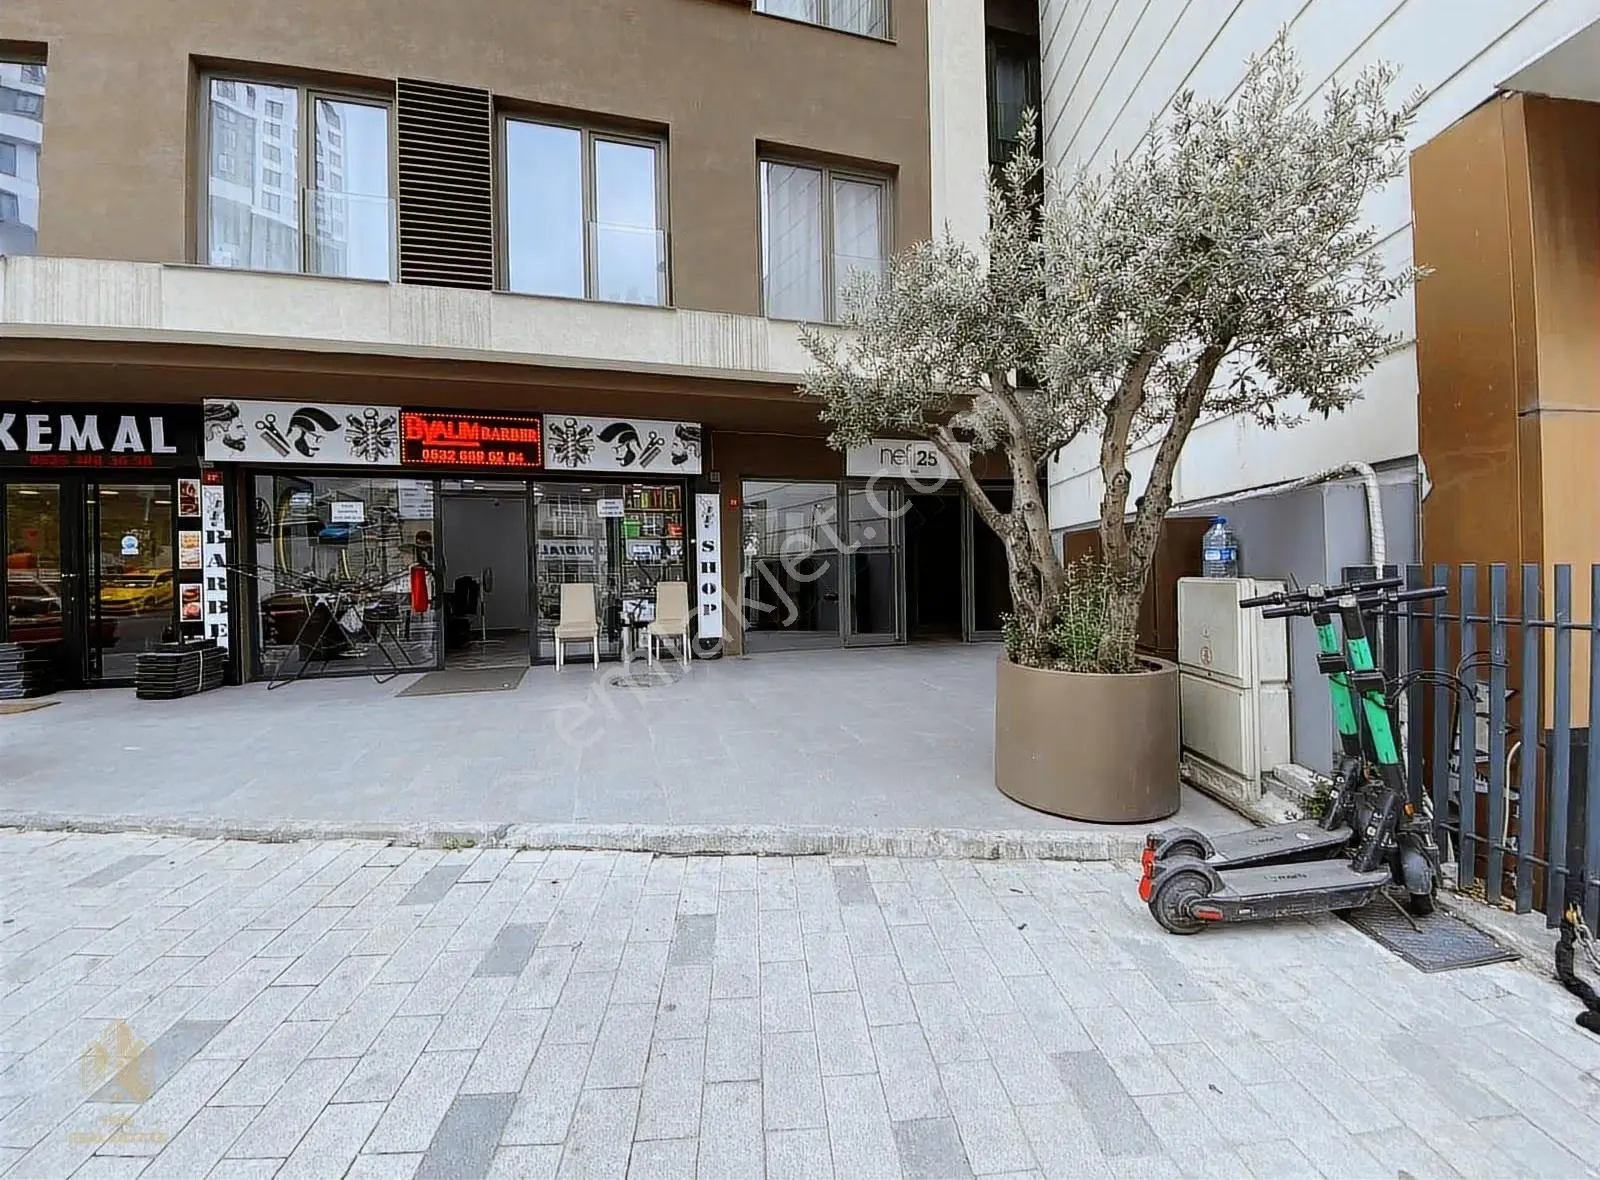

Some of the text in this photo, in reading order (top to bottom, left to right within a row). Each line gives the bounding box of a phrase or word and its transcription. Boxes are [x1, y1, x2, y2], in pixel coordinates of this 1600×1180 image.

[0, 413, 177, 453] KEMAL
[916, 451, 938, 467] 25
[206, 530, 228, 638] BARBE
[701, 540, 717, 616] SHOP
